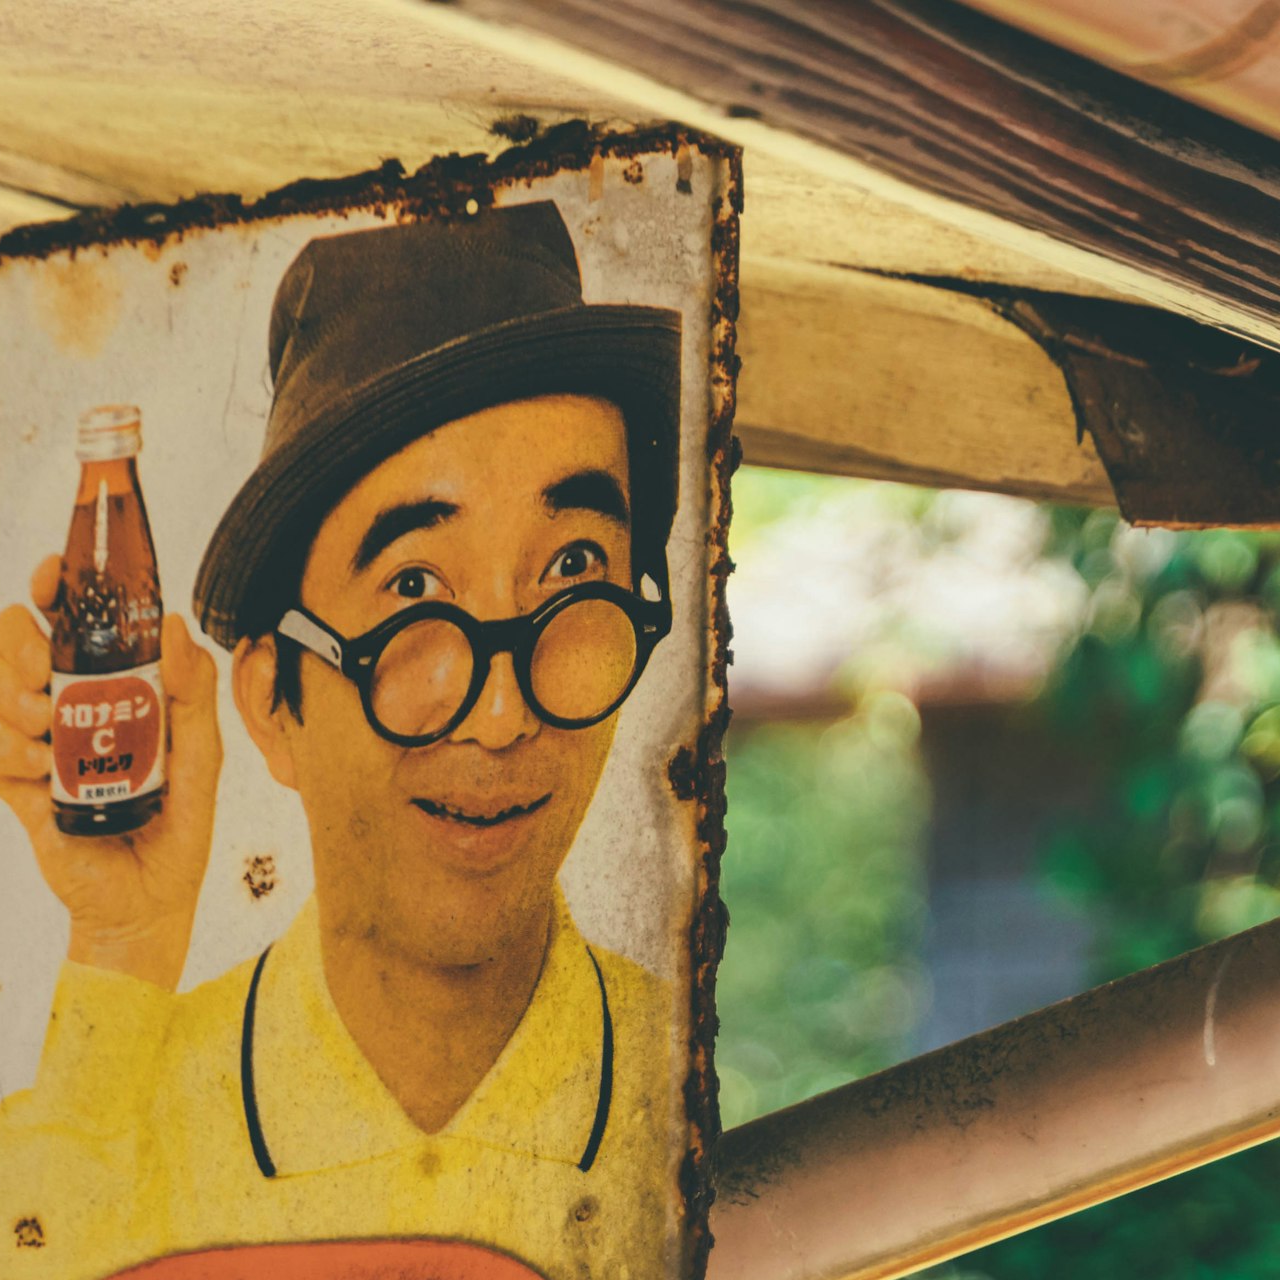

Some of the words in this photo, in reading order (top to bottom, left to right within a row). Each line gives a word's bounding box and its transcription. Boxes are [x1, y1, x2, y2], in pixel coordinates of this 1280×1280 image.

[58, 696, 152, 728] オロナミン
[91, 728, 116, 755] C
[78, 753, 134, 776] ドリンク
